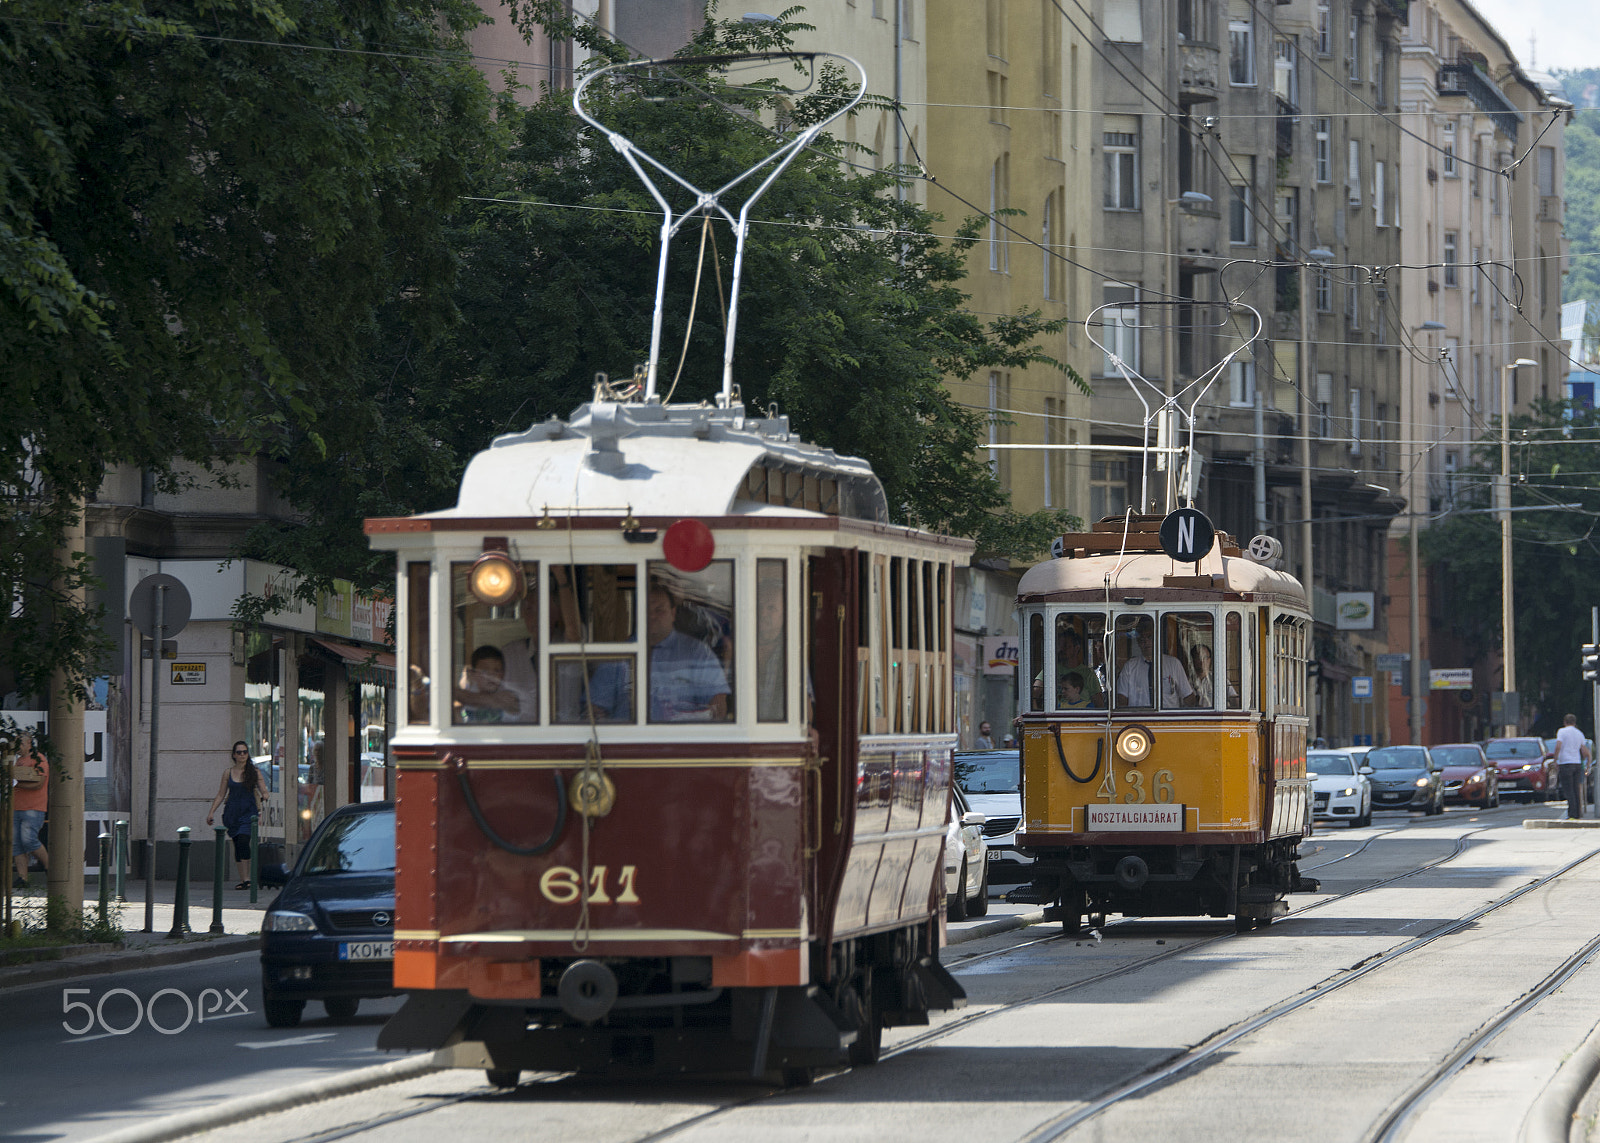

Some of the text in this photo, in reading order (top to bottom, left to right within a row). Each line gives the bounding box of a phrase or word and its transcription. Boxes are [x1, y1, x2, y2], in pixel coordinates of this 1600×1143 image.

[1177, 516, 1195, 554] N
[1096, 768, 1175, 804] 436
[1091, 810, 1178, 823] NOSZTALGIAJÁRAT
[539, 865, 641, 905] 611
